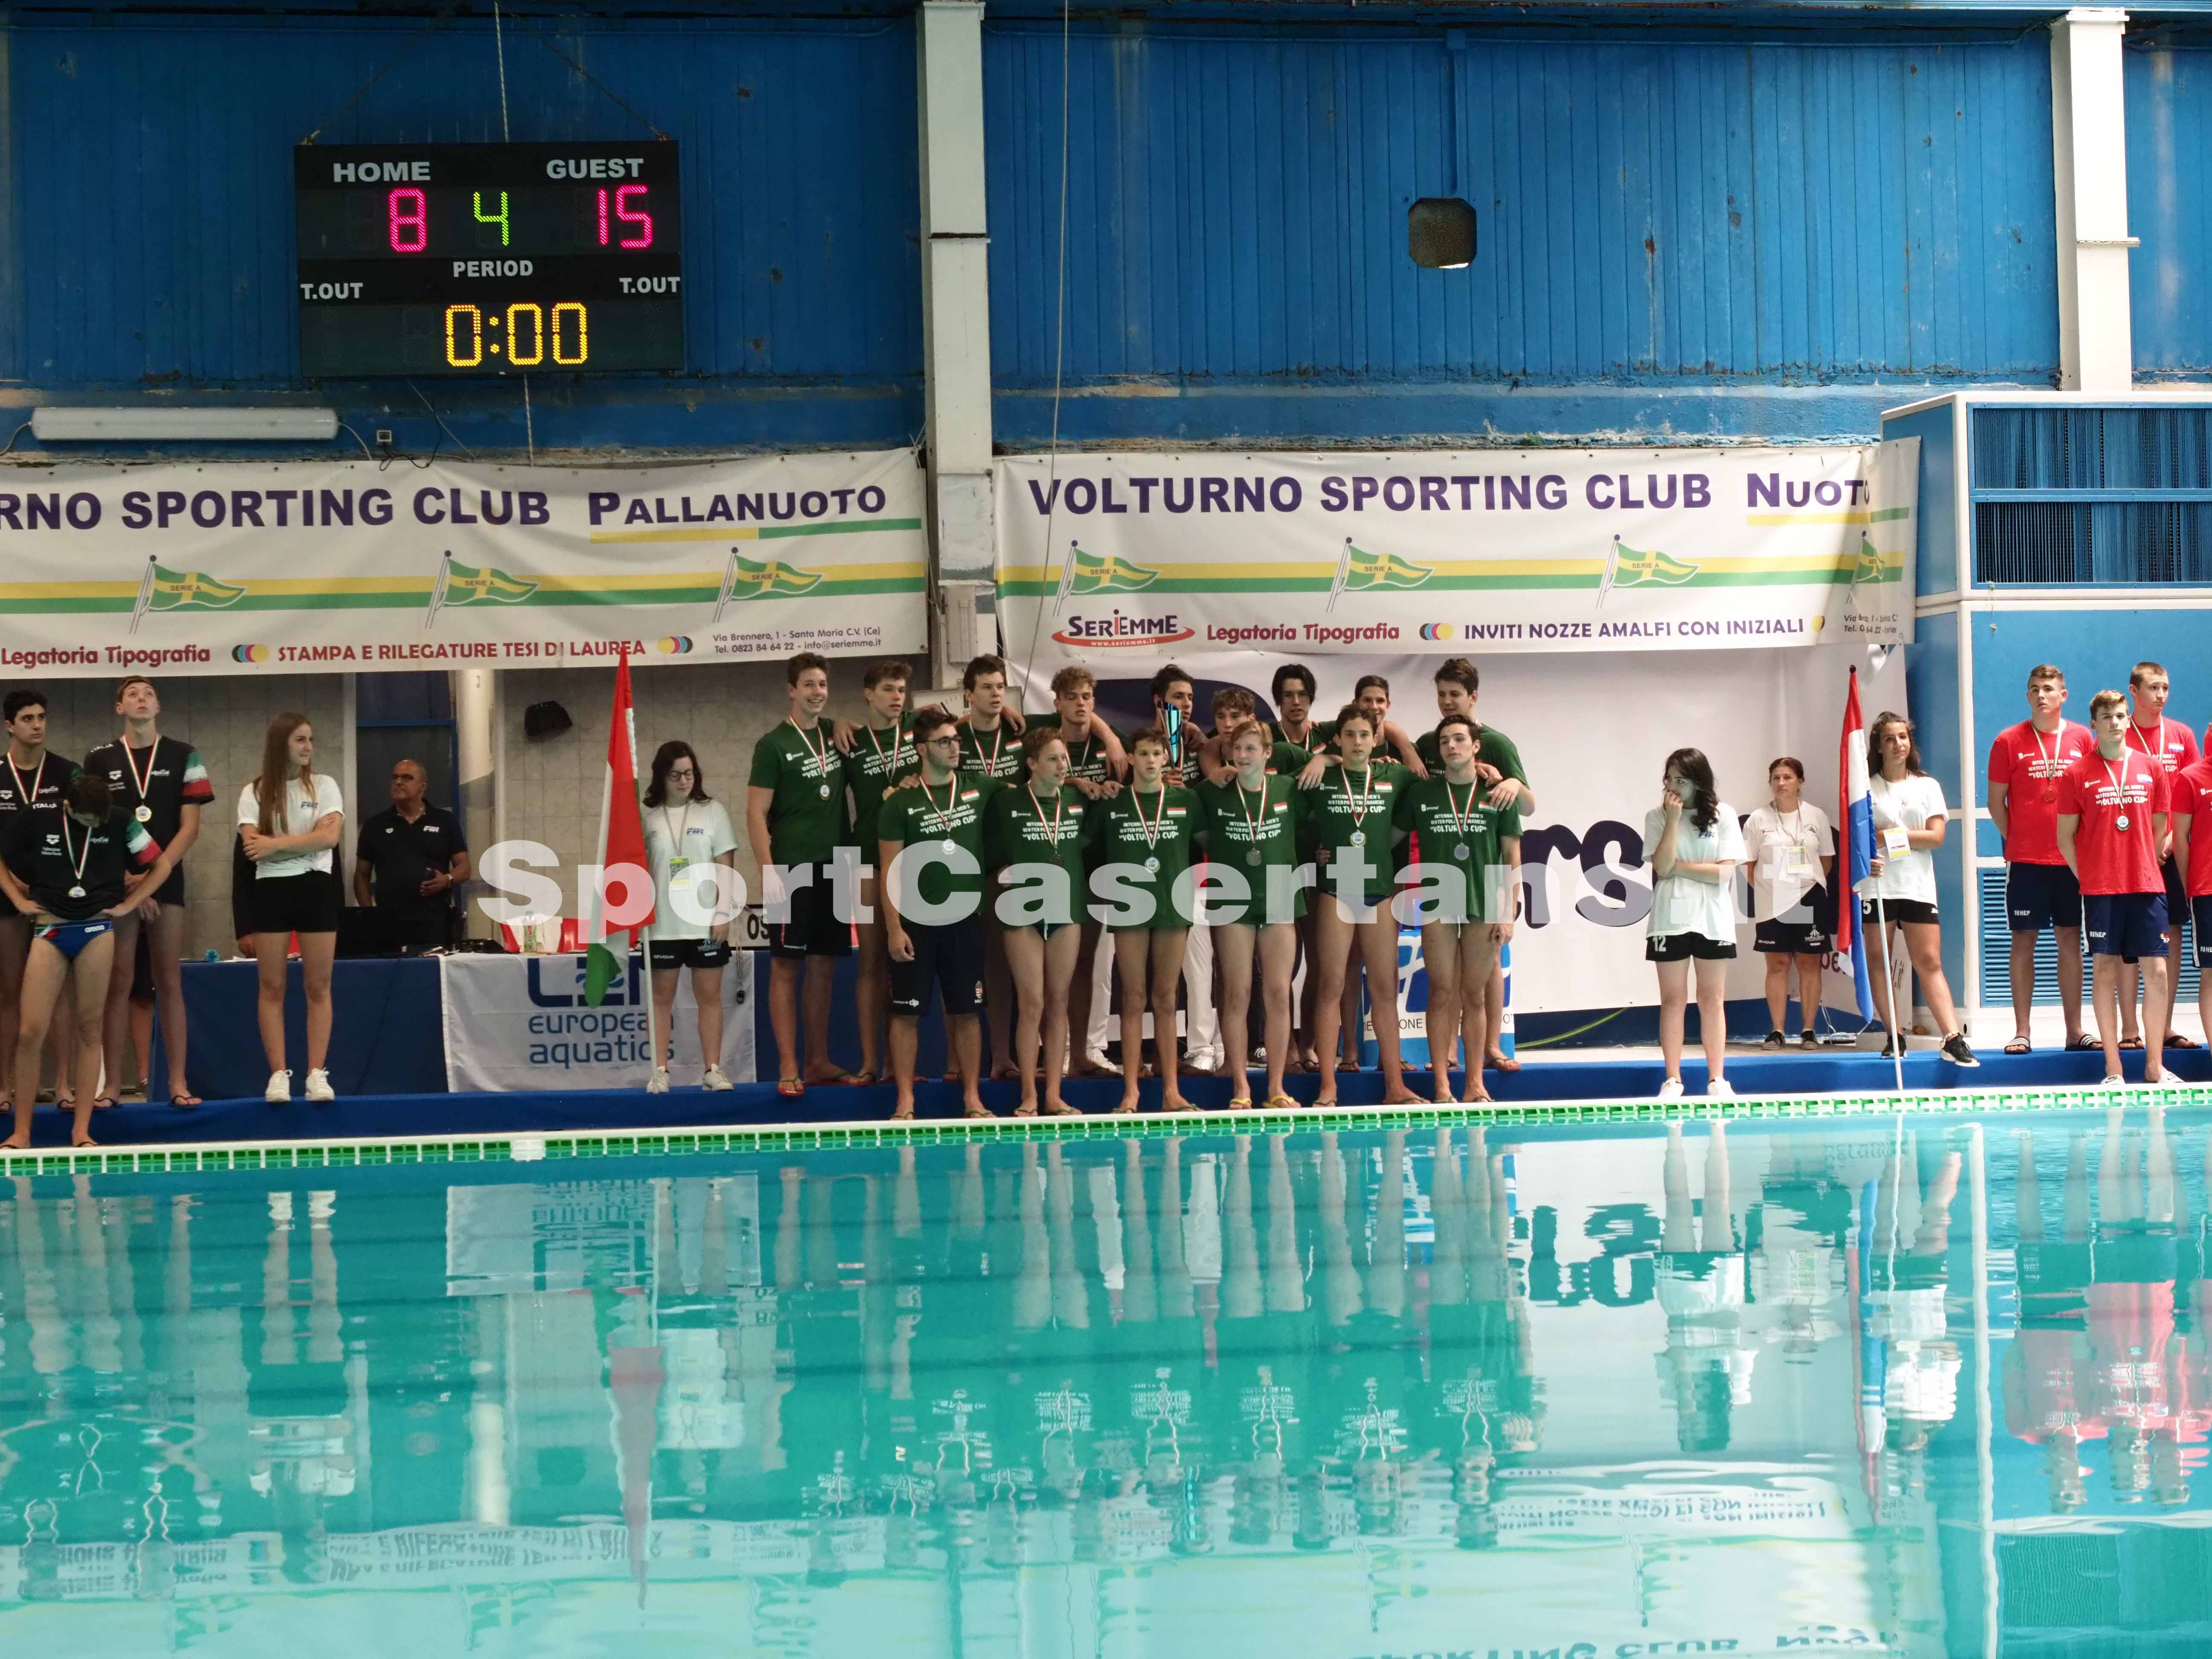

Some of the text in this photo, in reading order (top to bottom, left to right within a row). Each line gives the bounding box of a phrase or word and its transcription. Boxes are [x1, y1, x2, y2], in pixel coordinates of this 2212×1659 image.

[333, 162, 431, 182] HOME
[547, 158, 644, 179] GUEST
[389, 187, 426, 252] 8
[474, 191, 509, 246] 4
[598, 185, 652, 248] 15
[453, 260, 533, 277] PERIOD
[301, 282, 364, 300] T.OUT
[620, 276, 681, 294] T.OUT
[446, 303, 588, 367] 0:00
[1028, 473, 1870, 515] VOLTURNO SPORTING CLUB NUOTO
[122, 487, 393, 530] SPORTING
[413, 486, 550, 526] CLUB
[590, 486, 886, 525] PALLANUOTO
[731, 632, 773, 641] Brennero,
[789, 630, 814, 638] Santa
[818, 629, 843, 637] Maria
[864, 627, 880, 636] (Ce)
[1207, 623, 1400, 644] Legatoria Tipografia
[1465, 618, 1804, 639] INVITI NOZZE AMALFI CON INIZIALI
[278, 645, 356, 662] STAMPA
[362, 645, 372, 660] E
[379, 642, 497, 660] RILEGATURE
[504, 642, 538, 658] TESI
[804, 639, 881, 650] info@seriemme.it
[2, 645, 210, 669] Legatoria Tipografia
[1653, 935, 1666, 952] 12
